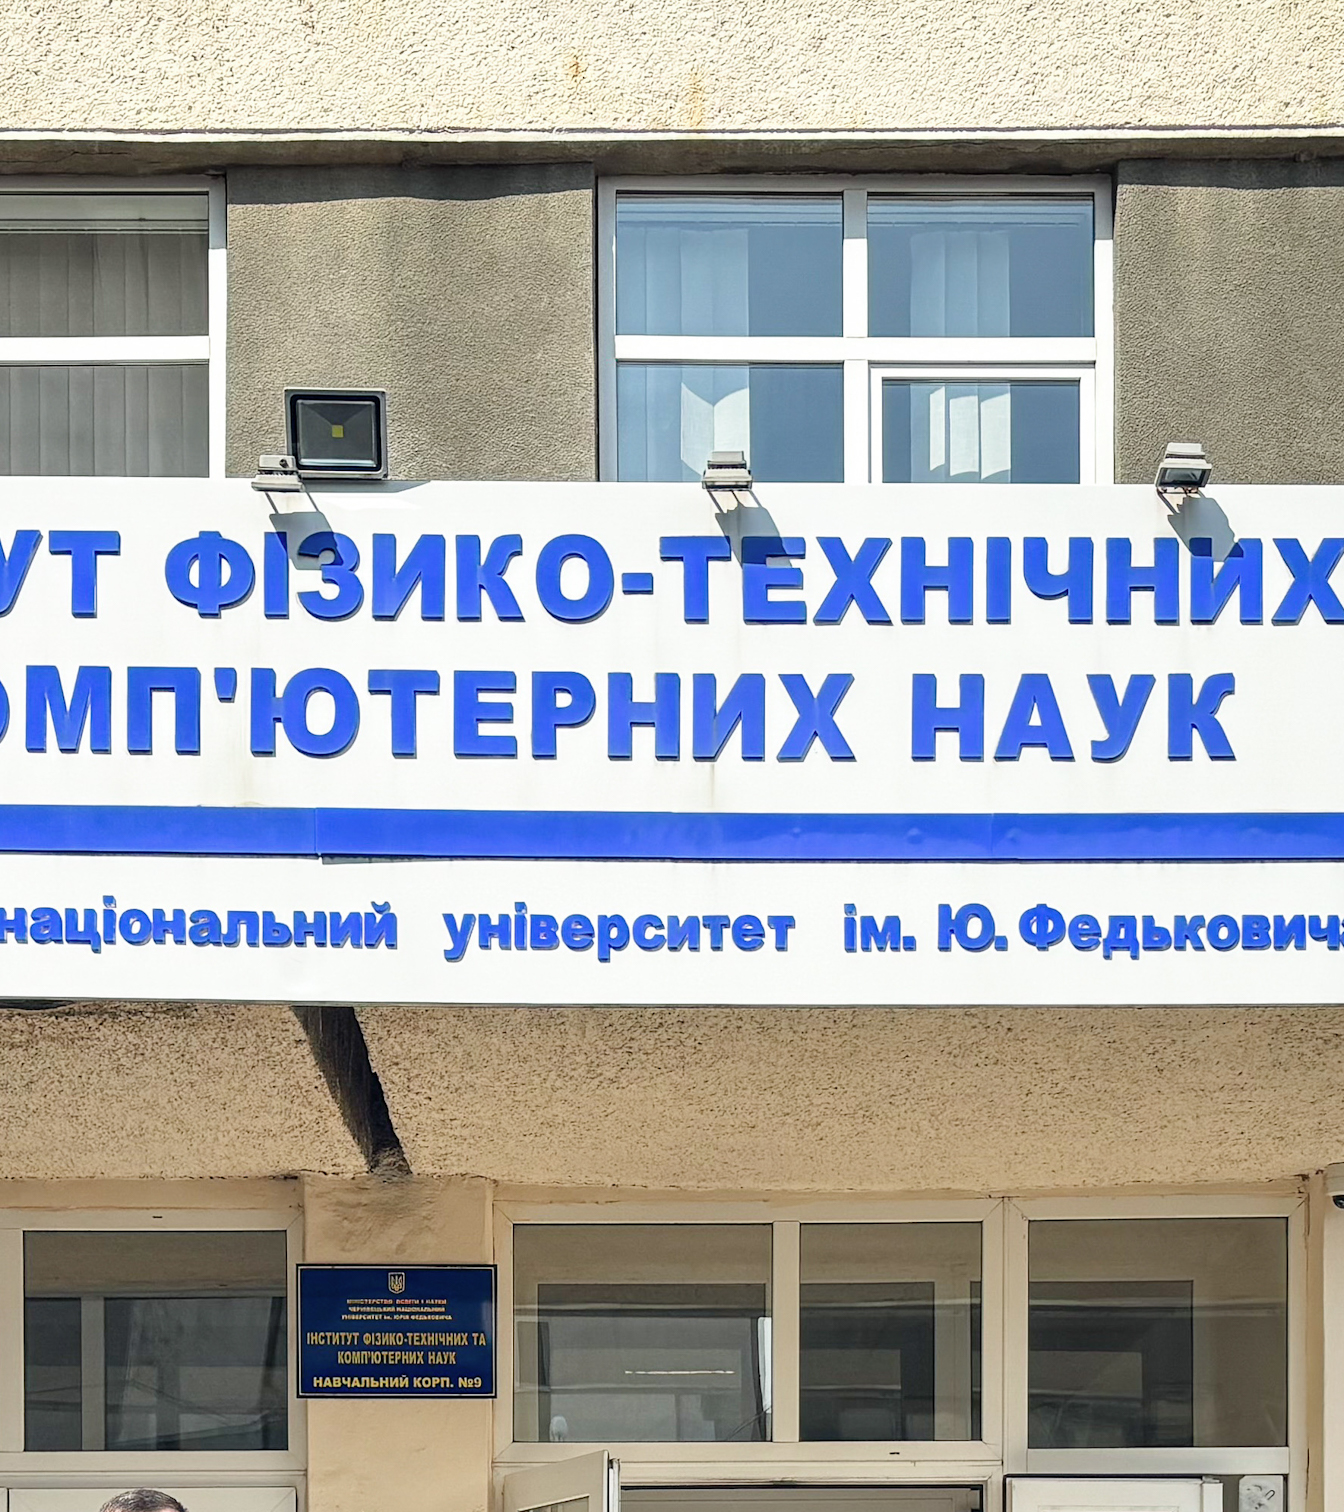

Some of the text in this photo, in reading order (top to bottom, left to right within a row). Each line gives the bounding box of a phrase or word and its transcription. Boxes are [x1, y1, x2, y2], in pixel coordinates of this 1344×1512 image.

[910, 671, 1237, 763] НАУК
[443, 902, 796, 963] університет
[844, 903, 916, 953] ім.
[307, 1332, 487, 1347] ІНСТИТУТ ФІЗИКО-ТЕХНІЧНИХ ТА
[428, 1352, 457, 1365] НАУК
[313, 1375, 482, 1388] НАВЧАЛЬНИЙ КОРП. №9
